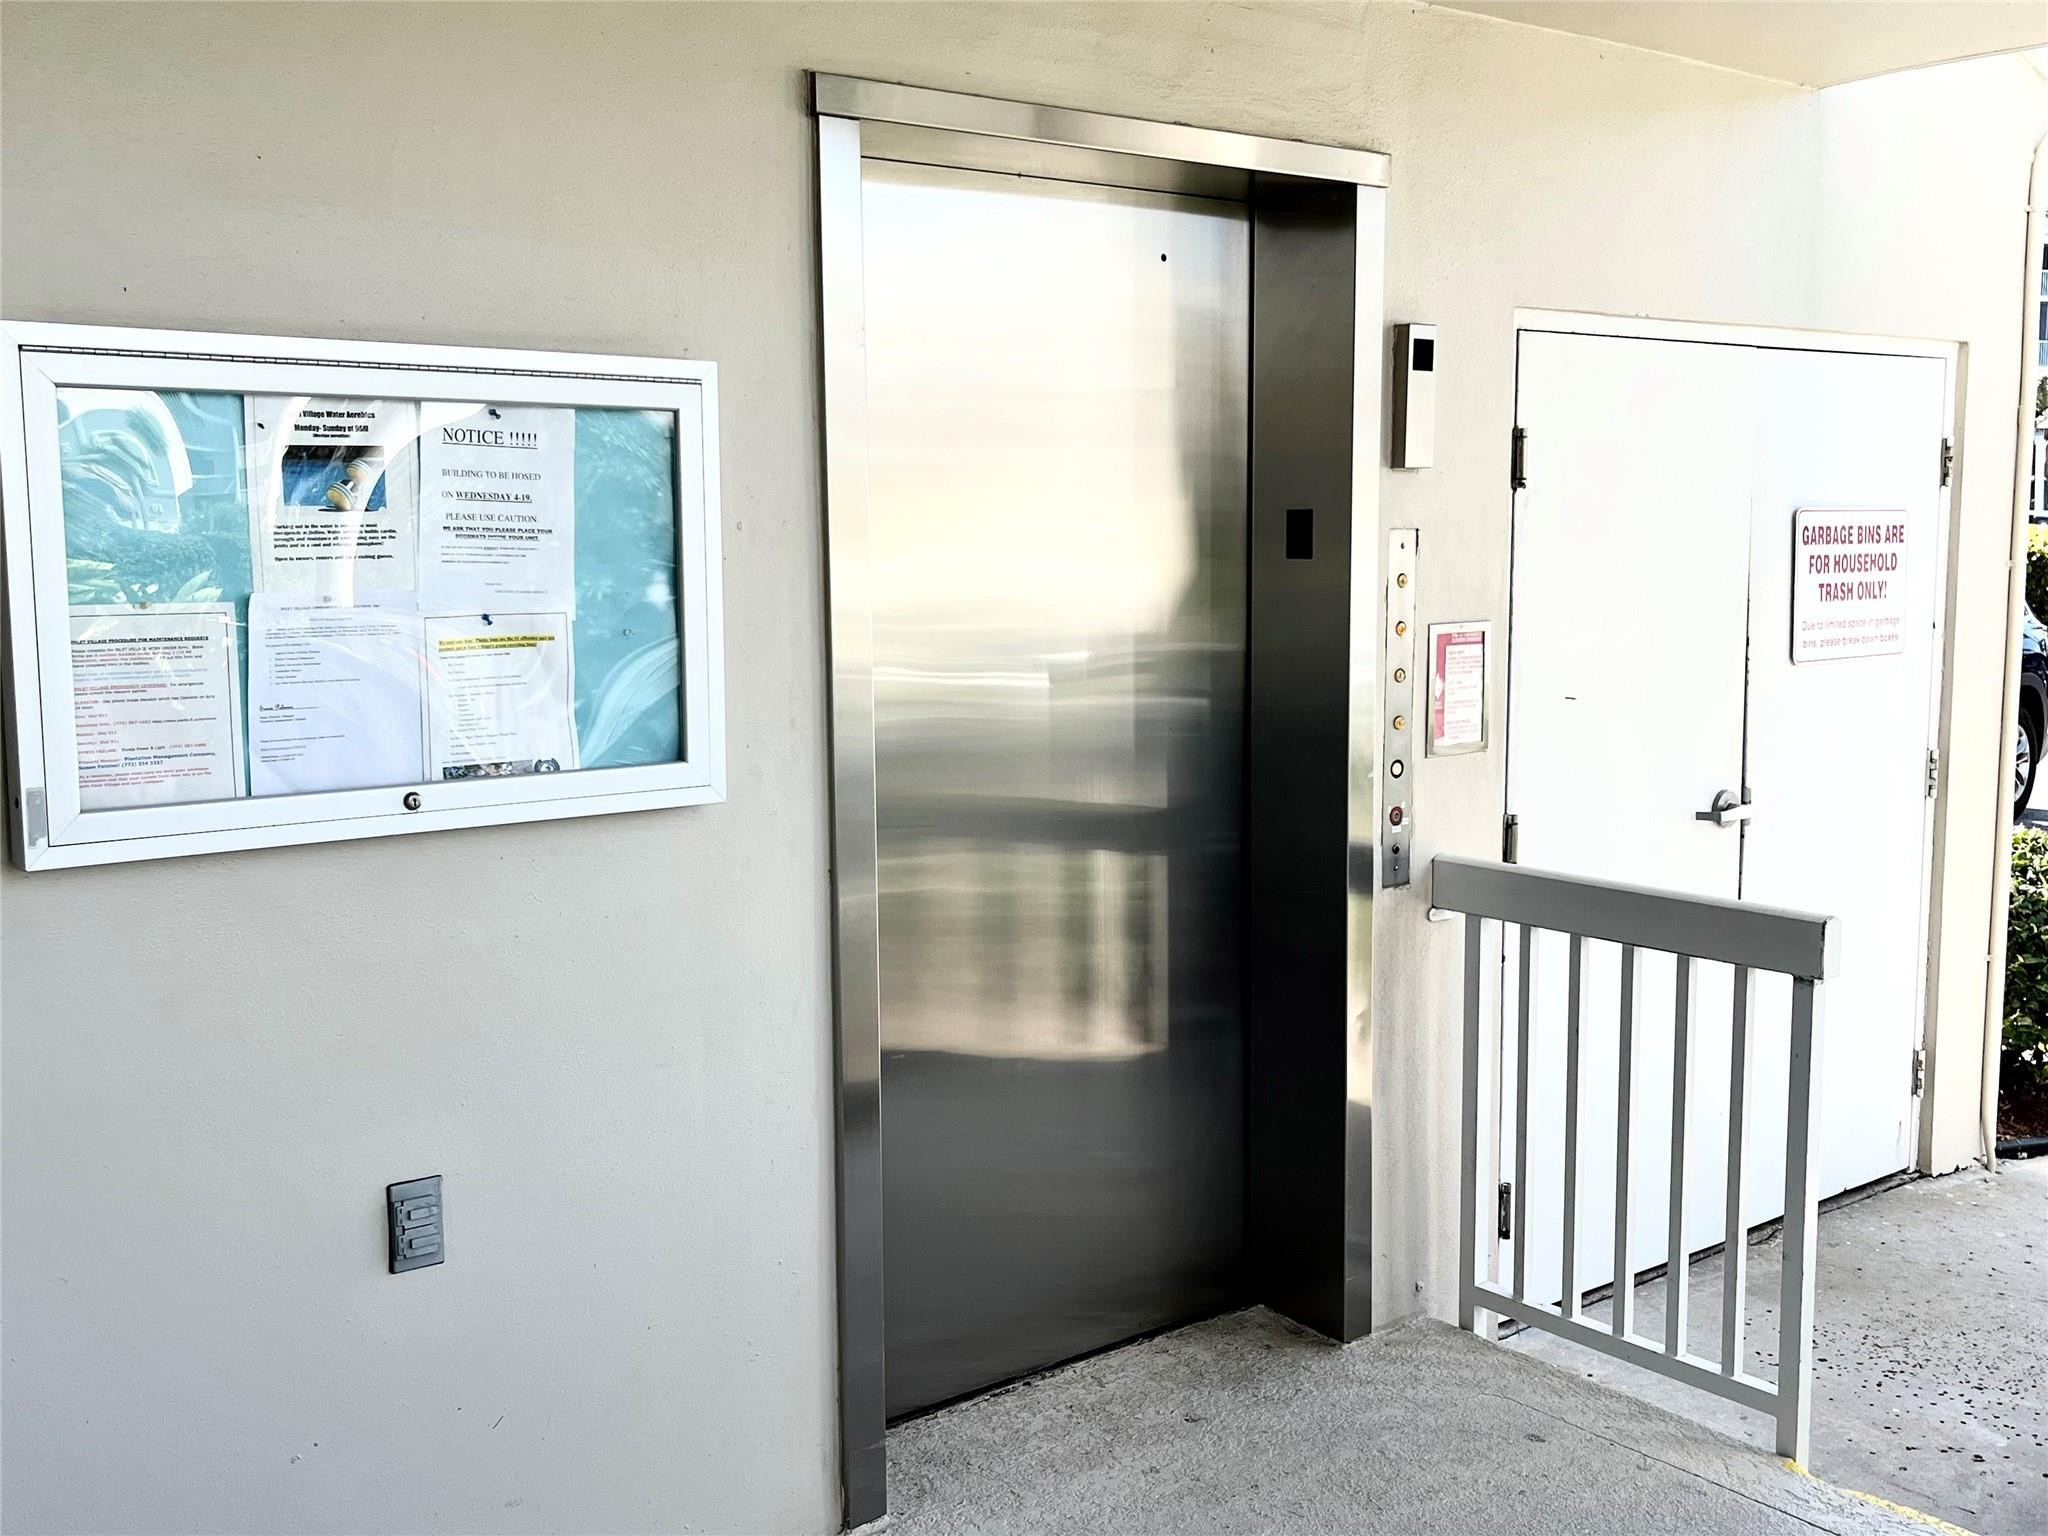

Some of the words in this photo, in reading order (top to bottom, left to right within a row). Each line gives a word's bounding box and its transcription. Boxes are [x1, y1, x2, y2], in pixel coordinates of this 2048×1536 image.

[325, 410, 345, 419] Water
[322, 424, 347, 433] Sunday
[442, 427, 505, 445] NOTICE
[442, 468, 483, 479] BUILDING
[484, 471, 497, 479] TO
[498, 472, 509, 480] BE
[511, 472, 541, 481] HOSED
[442, 490, 454, 499] ON
[455, 491, 512, 501] WEDNESDAY
[445, 512, 479, 521] PLEASE
[479, 513, 496, 521] USE
[1802, 525, 1854, 546] GARBAGE
[1857, 525, 1882, 545] BINS
[1884, 524, 1905, 544] ARE
[1809, 554, 1830, 575] FOR
[1834, 552, 1898, 574] HOUSEHOLD
[1818, 582, 1854, 602] TRASH
[1857, 580, 1887, 601] ONLY!
[1802, 620, 1815, 631] Due
[1817, 621, 1824, 630] to
[1824, 619, 1846, 629] limited
[1848, 618, 1866, 630] space
[1875, 616, 1900, 628] garbage
[1820, 636, 1842, 648] please
[1842, 635, 1860, 646] break
[153, 753, 188, 761] Management
